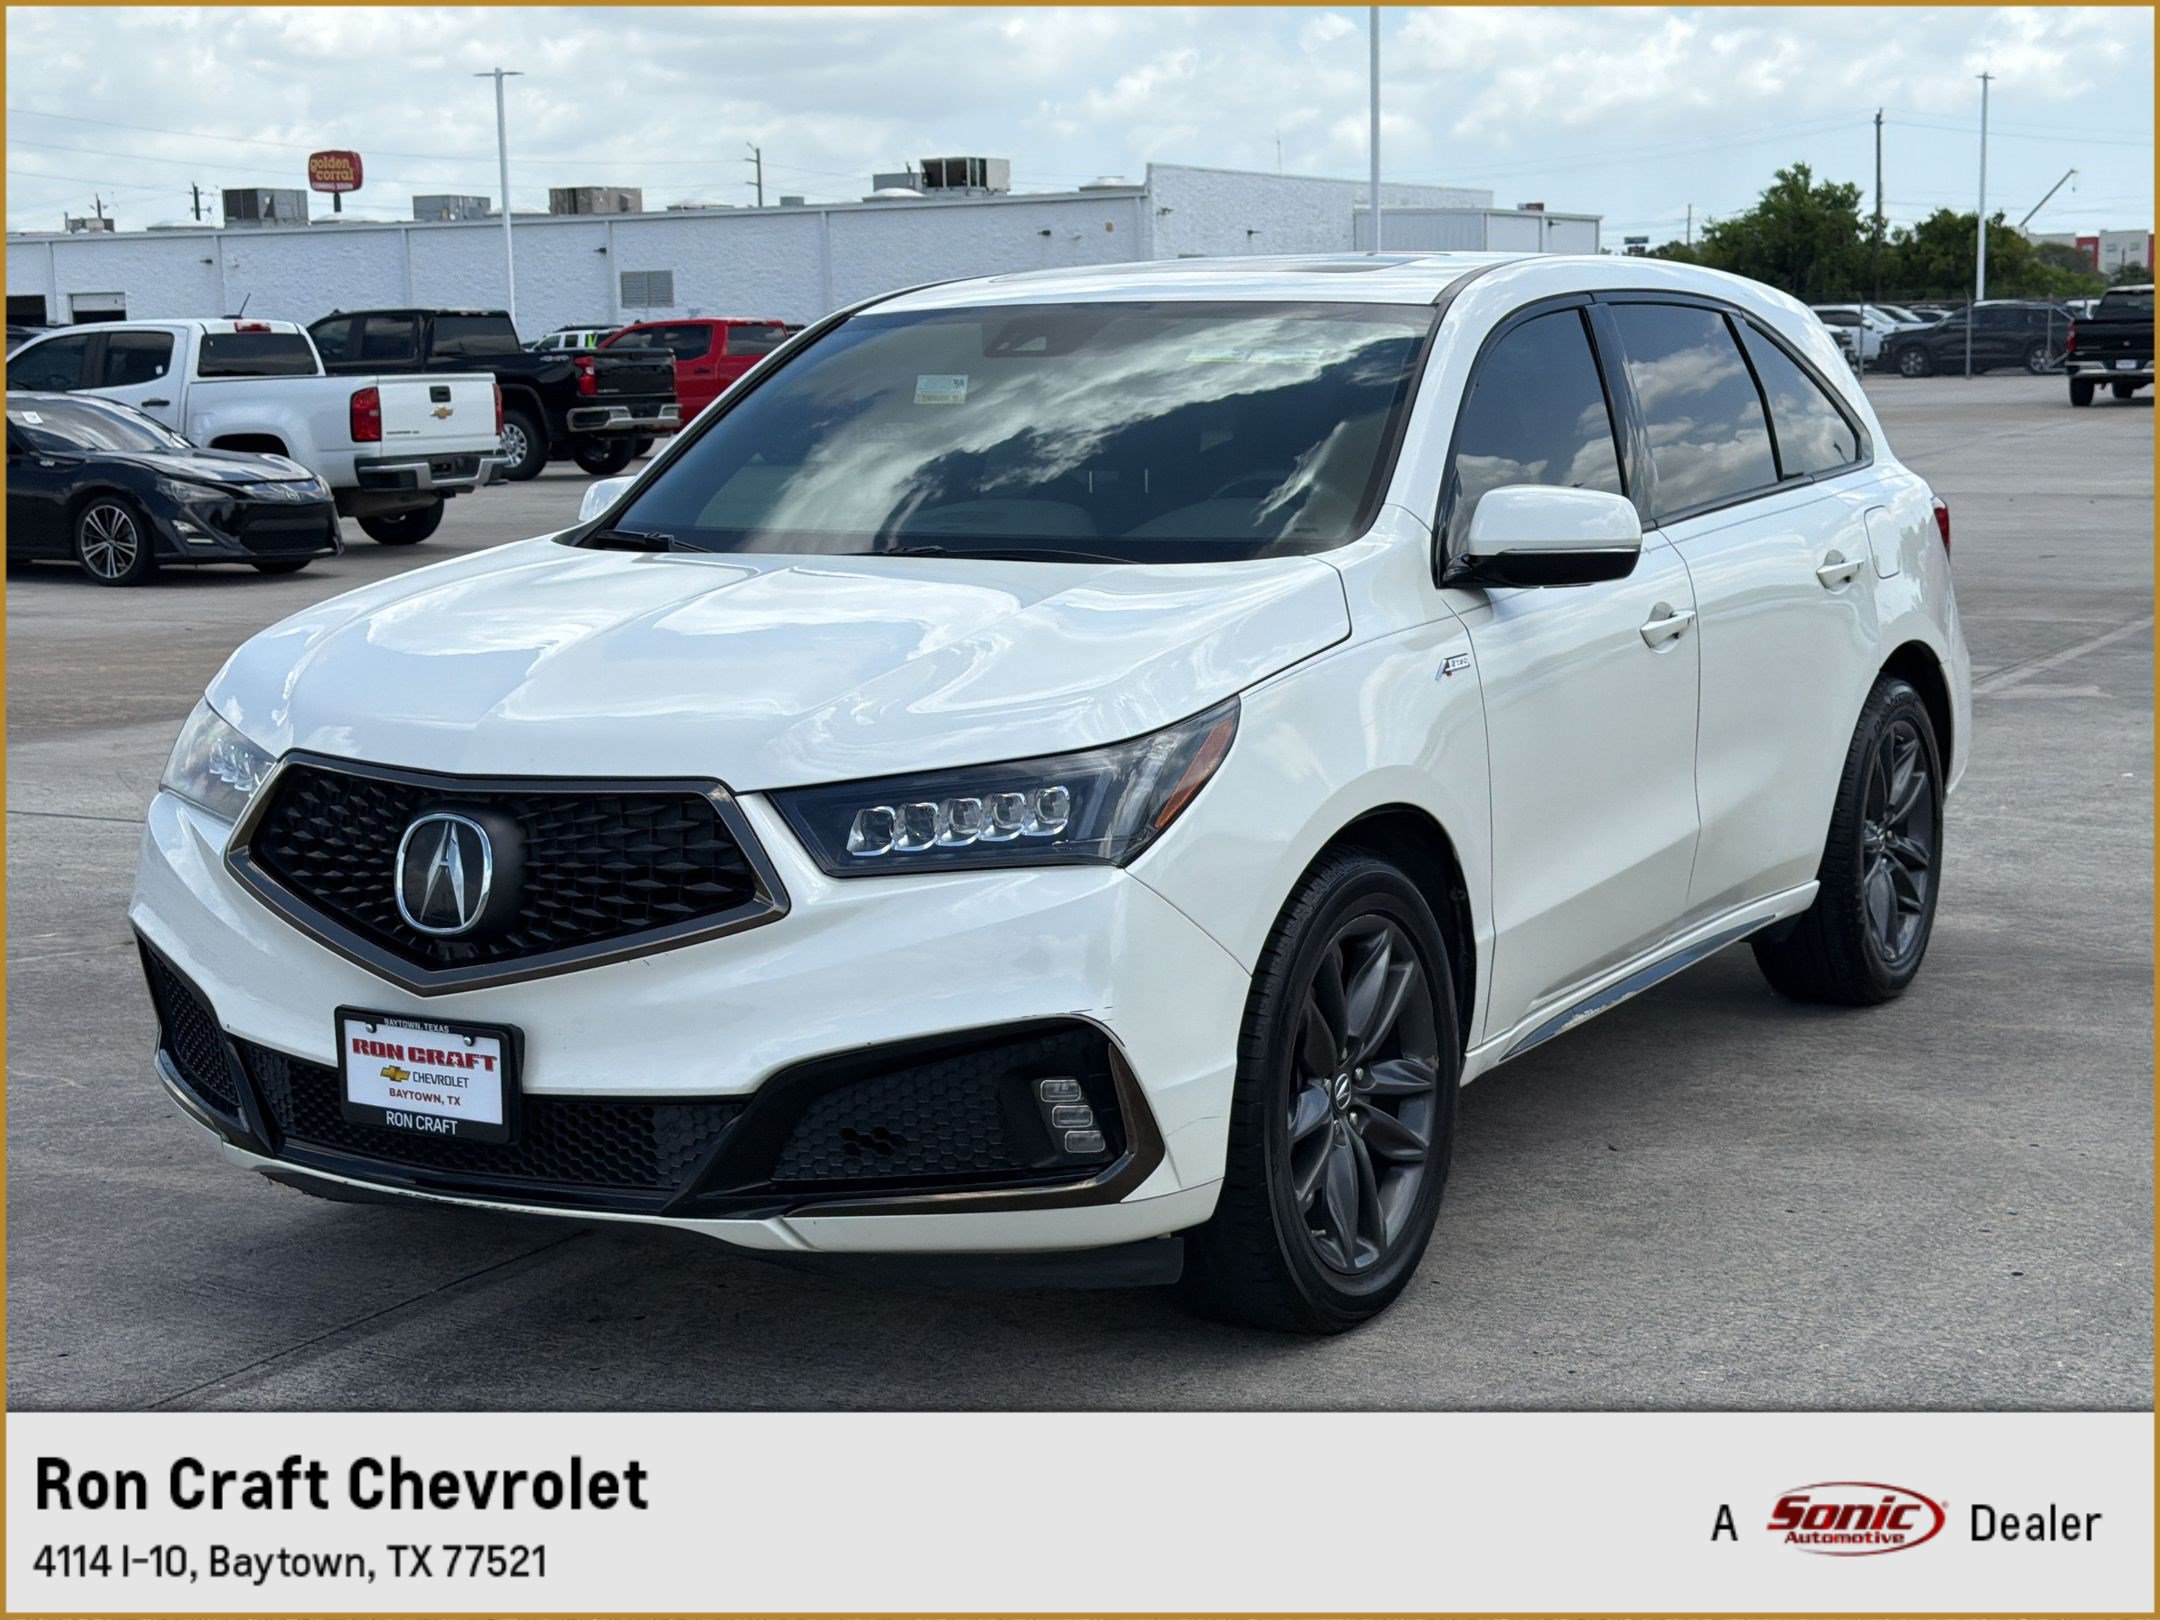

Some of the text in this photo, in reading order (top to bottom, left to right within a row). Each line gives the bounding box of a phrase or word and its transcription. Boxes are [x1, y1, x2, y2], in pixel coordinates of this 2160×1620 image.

[311, 156, 350, 173] golden
[316, 168, 354, 180] corral
[423, 1022, 449, 1033] TEXAS
[352, 1038, 498, 1072] RON CRAFT
[412, 1071, 470, 1088] CHEVROLET
[389, 1087, 461, 1106] BAYTOWN, TX
[385, 1110, 458, 1135] RON CRAFT
